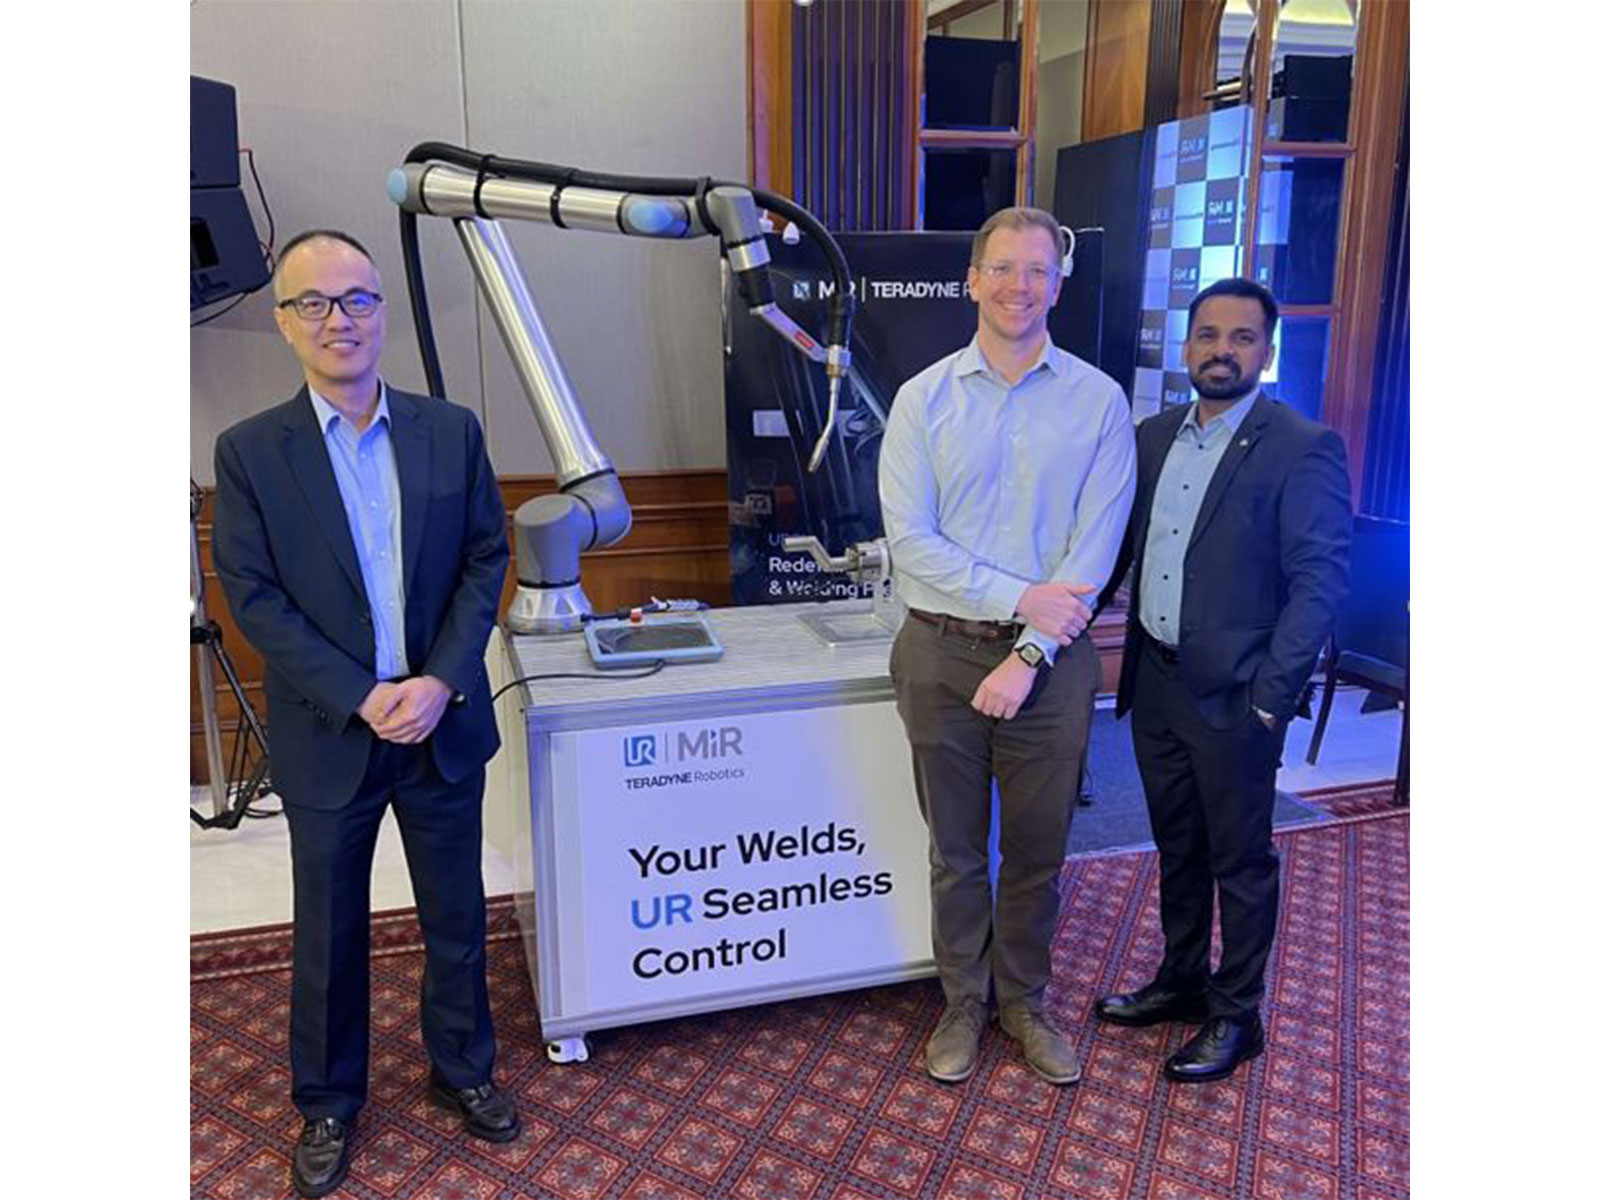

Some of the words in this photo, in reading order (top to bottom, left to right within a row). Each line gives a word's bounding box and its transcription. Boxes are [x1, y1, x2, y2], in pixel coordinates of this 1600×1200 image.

[871, 281, 960, 298] TERADYNE
[769, 581, 782, 596] &
[624, 735, 656, 767] UR
[678, 726, 743, 762] MiR
[625, 772, 692, 790] TERADYNE
[694, 769, 745, 783] Robotics
[629, 845, 726, 878] Your
[736, 822, 866, 865] Welds,
[631, 893, 693, 929] UR
[703, 872, 893, 919] Seamless
[632, 928, 786, 979] Control
